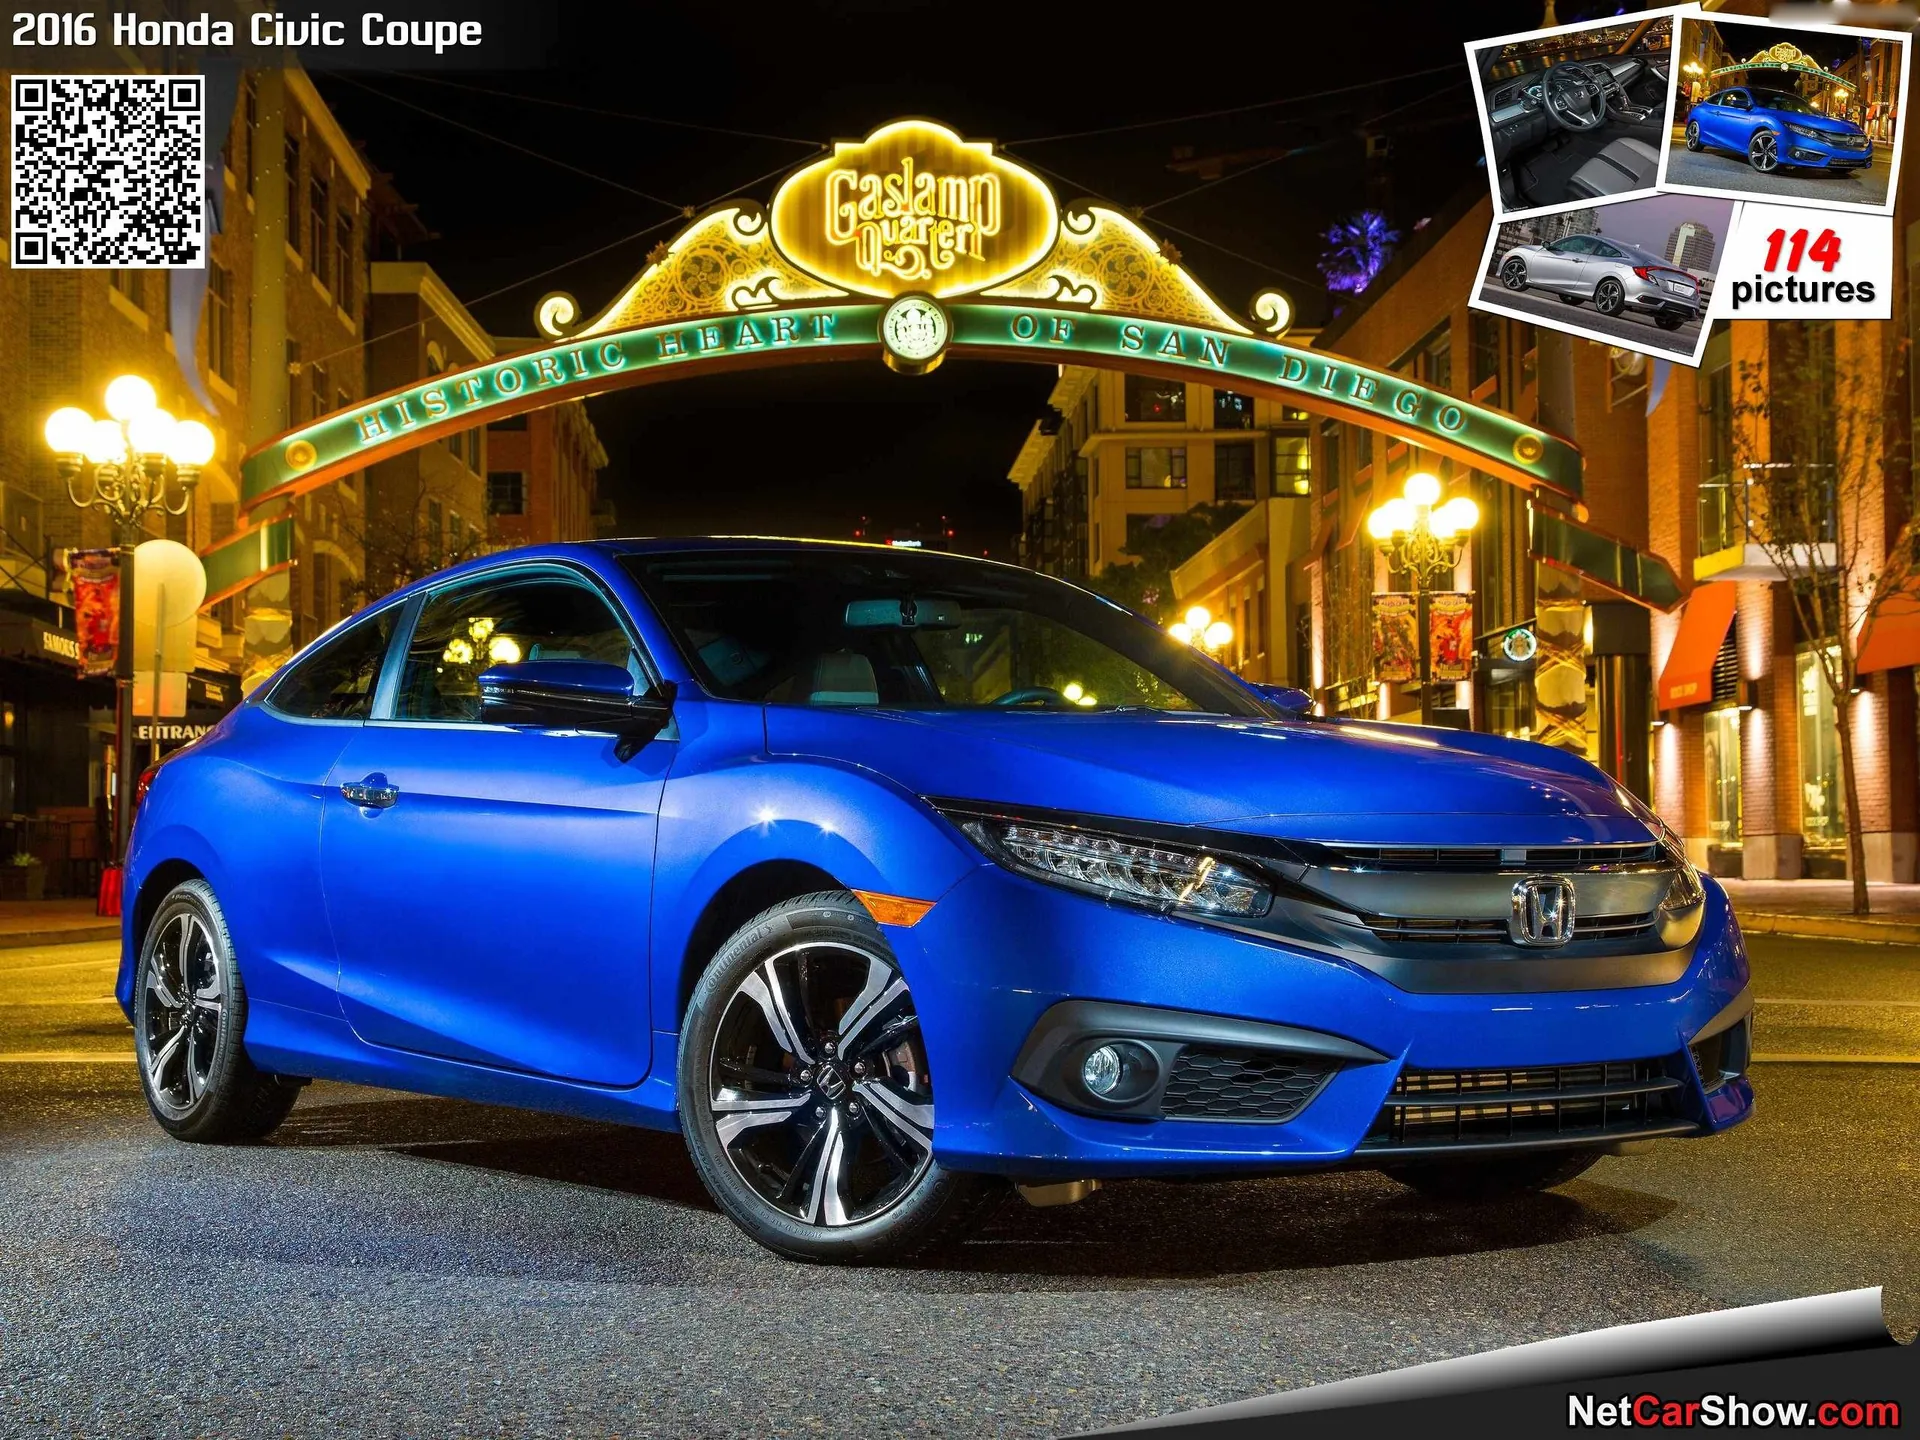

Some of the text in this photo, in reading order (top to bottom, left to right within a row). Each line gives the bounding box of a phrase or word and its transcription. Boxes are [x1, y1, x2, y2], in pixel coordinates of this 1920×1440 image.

[825, 156, 1001, 246] Gaslamp
[354, 341, 624, 446] HISTORIC
[656, 312, 835, 361] HEART
[1010, 312, 1078, 345] OF
[1121, 324, 1233, 368] SAN
[1278, 352, 1468, 433] DIEGO
